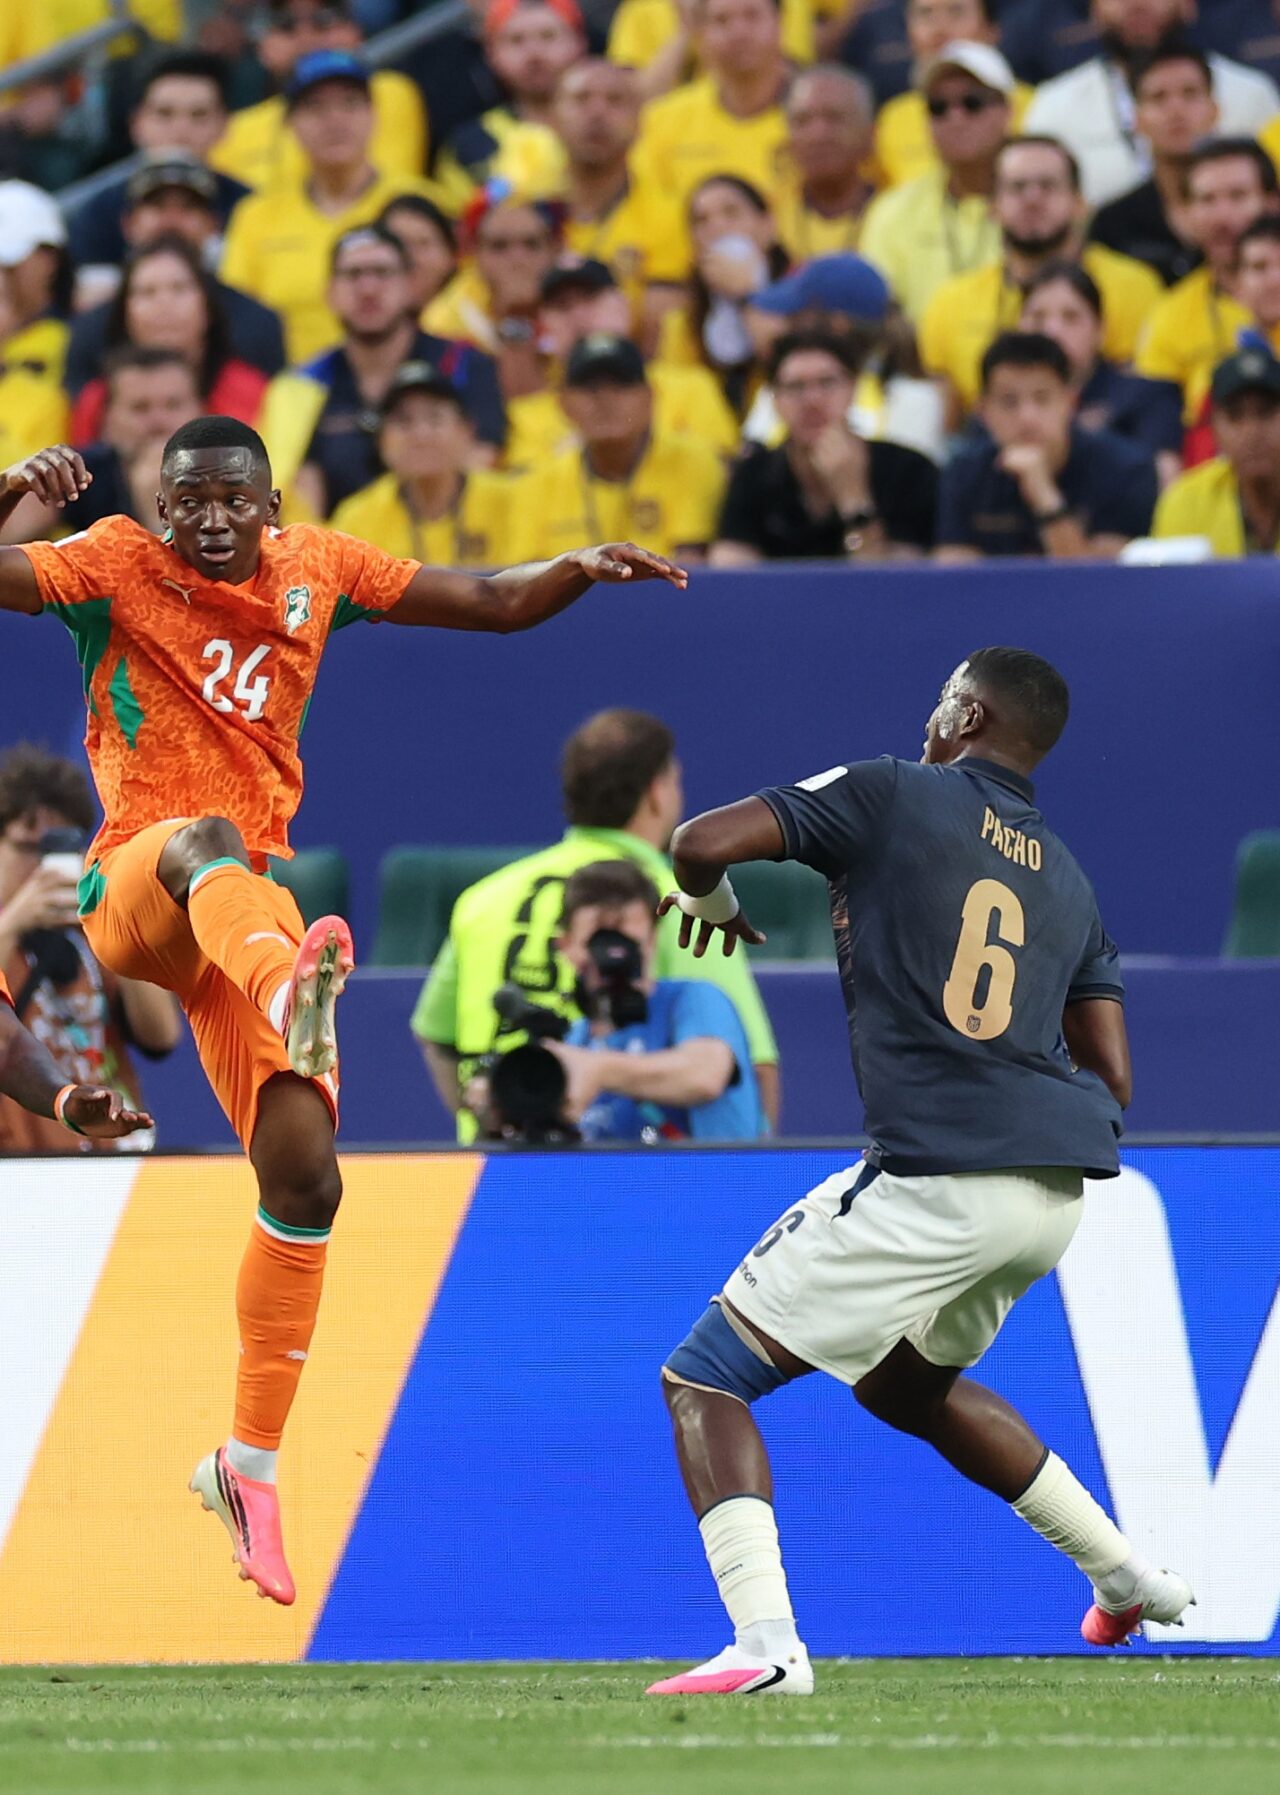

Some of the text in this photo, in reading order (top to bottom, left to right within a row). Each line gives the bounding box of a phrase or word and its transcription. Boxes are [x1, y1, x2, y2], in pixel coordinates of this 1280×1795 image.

[202, 638, 272, 721] 24
[980, 805, 1042, 872] PACHO
[943, 878, 1024, 1041] 6
[753, 1210, 805, 1258] 6
